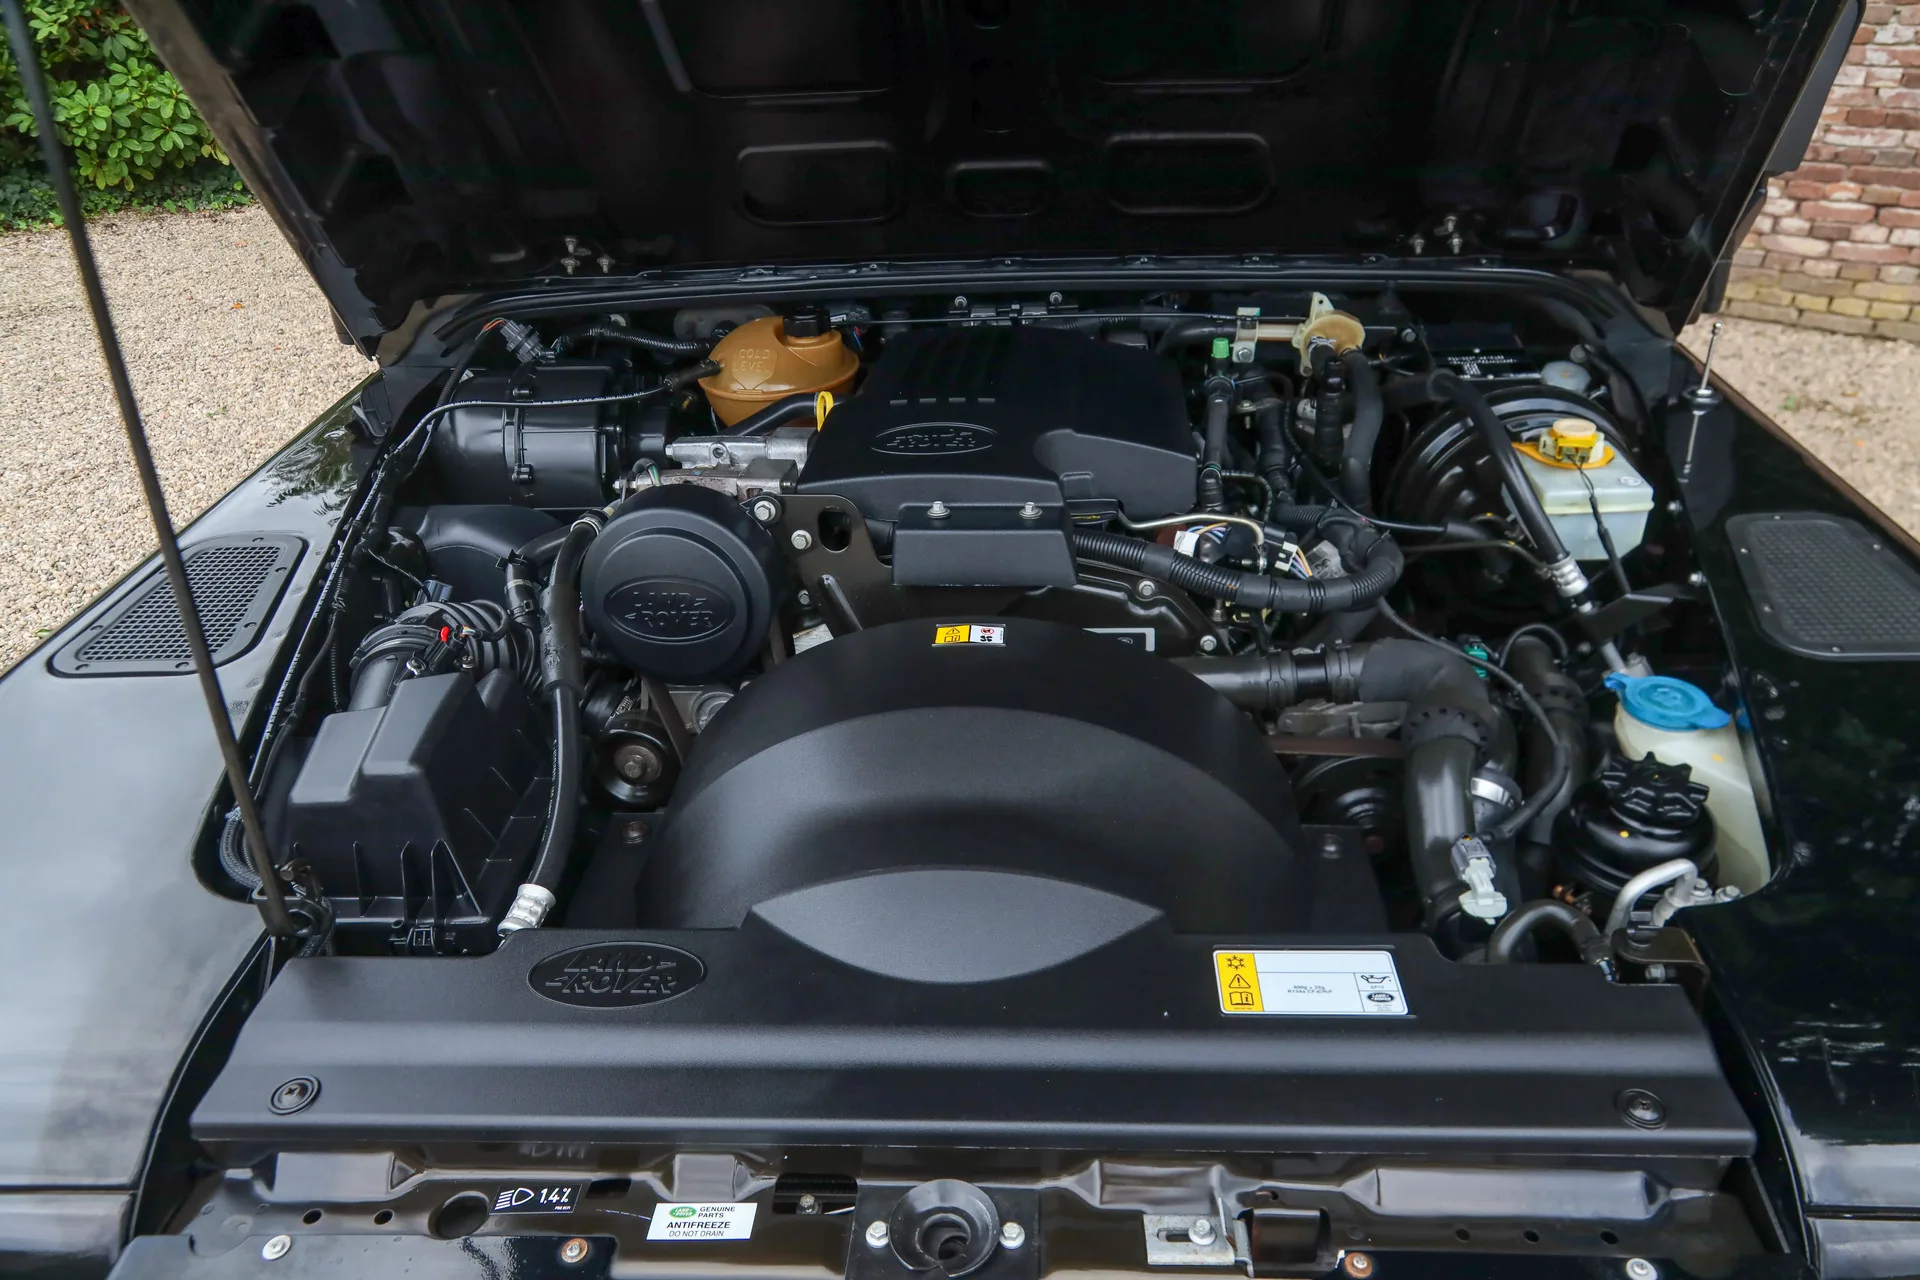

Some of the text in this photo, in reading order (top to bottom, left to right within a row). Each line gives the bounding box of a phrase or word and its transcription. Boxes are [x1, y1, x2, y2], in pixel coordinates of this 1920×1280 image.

[739, 348, 771, 359] COLD
[631, 592, 693, 607] LAND
[637, 610, 714, 628] ROVER
[563, 951, 653, 973] LAND
[561, 972, 677, 994] ROVER
[666, 1221, 731, 1229] ANTIFREEZE
